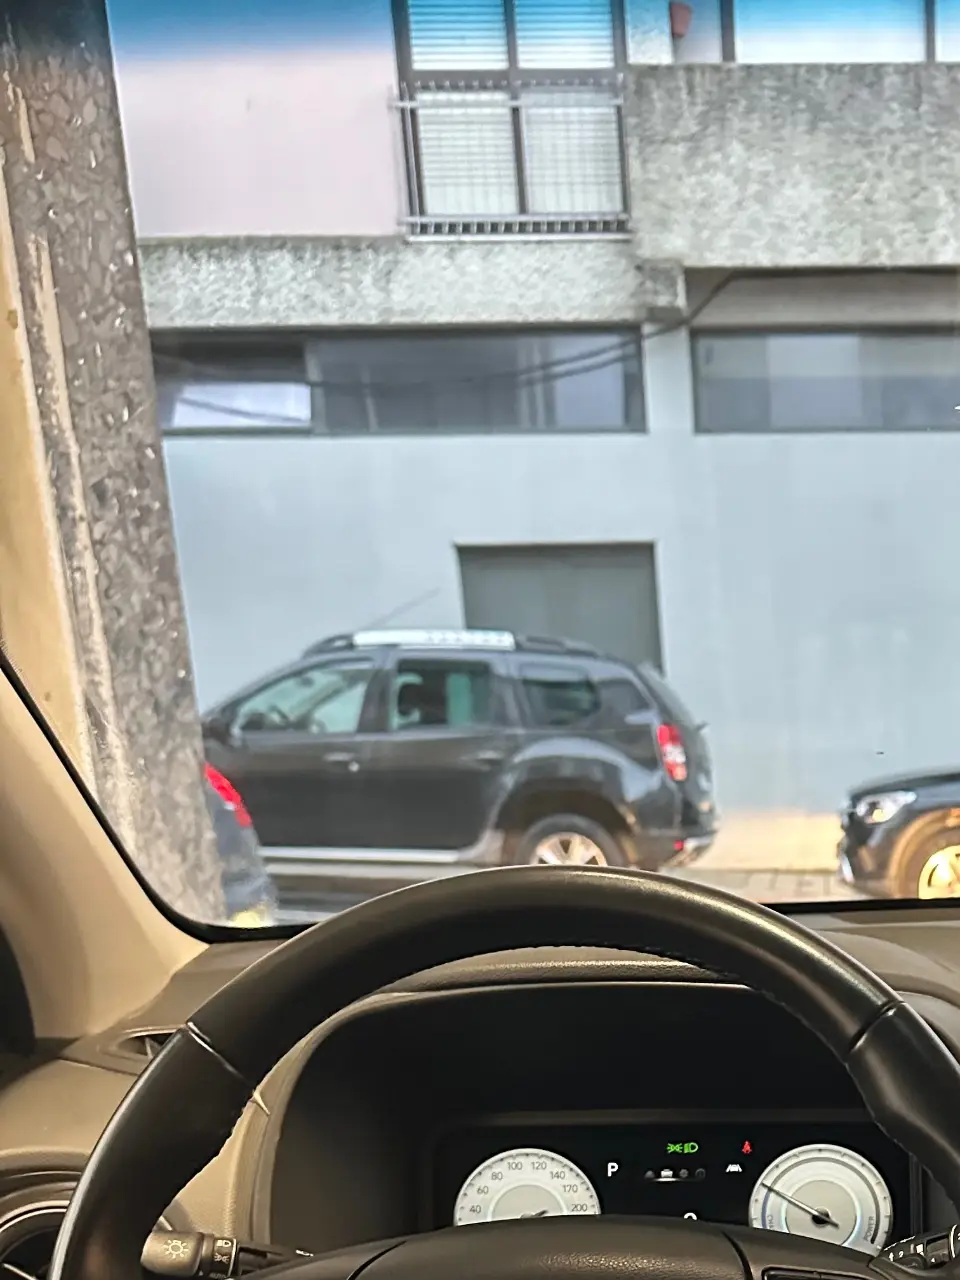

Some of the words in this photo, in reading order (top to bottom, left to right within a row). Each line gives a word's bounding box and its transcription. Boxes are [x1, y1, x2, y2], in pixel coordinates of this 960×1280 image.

[507, 1161, 523, 1170] 100
[531, 1161, 548, 1170] 120
[607, 1162, 619, 1177] P
[490, 1171, 503, 1181] 80
[549, 1171, 566, 1180] 140
[476, 1185, 489, 1195] 60
[563, 1184, 578, 1193] 170
[469, 1204, 482, 1213] 40
[571, 1203, 588, 1212] 200
[863, 1215, 875, 1242] POWER
